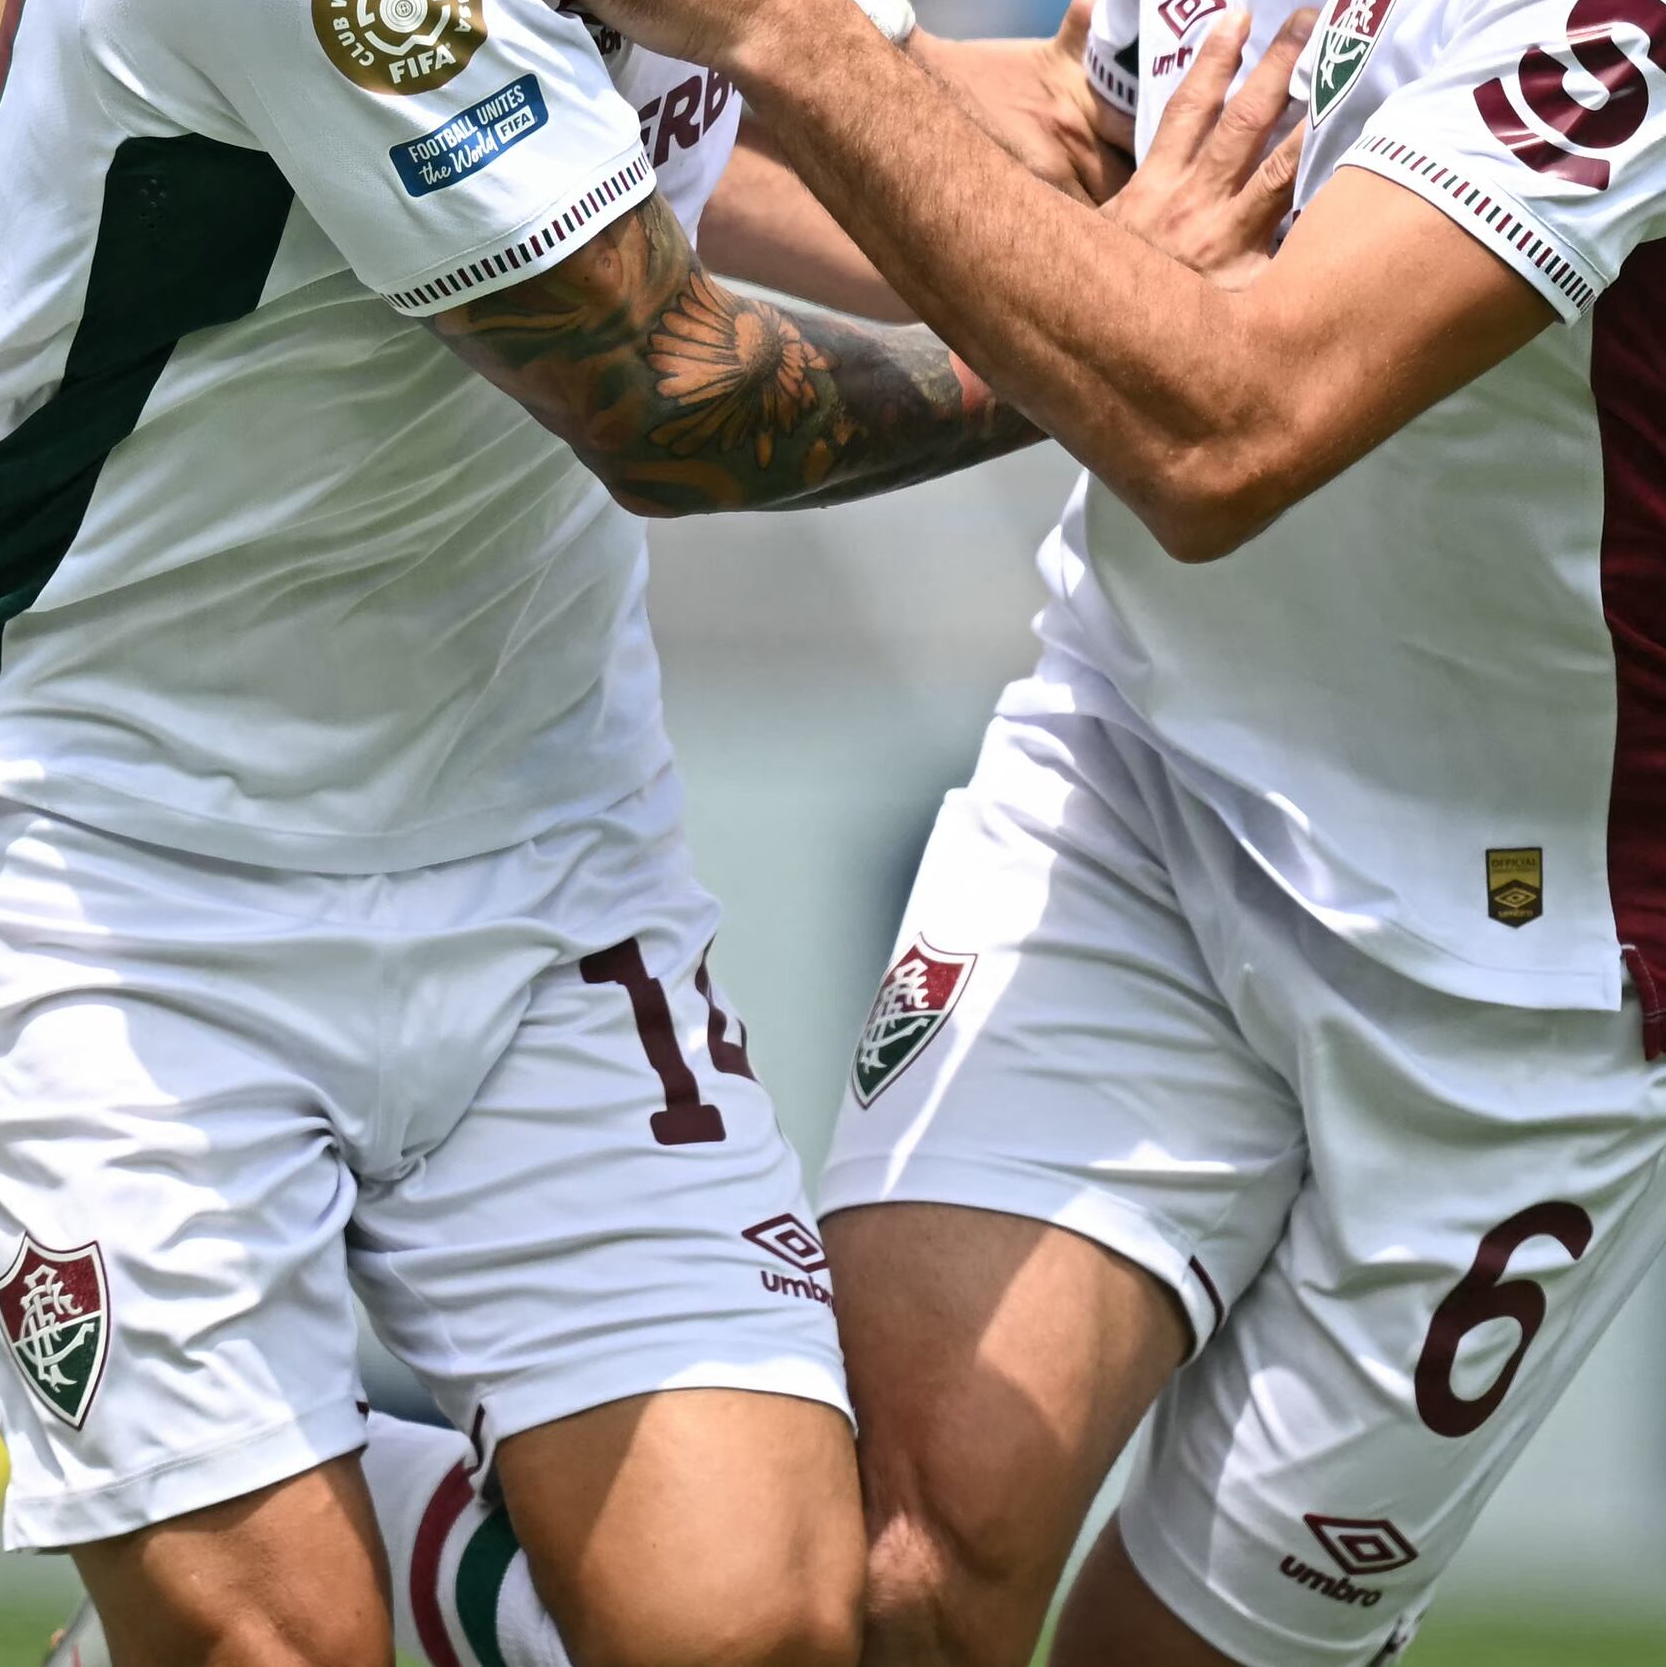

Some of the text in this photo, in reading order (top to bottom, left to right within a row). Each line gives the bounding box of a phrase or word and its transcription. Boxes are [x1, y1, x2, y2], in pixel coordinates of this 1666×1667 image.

[333, 16, 375, 67] CLUB
[389, 43, 456, 84] FIFA
[408, 84, 525, 163] FOOTBALL UNITES
[499, 112, 532, 138] FIFA
[419, 127, 499, 185] the World
[1414, 1200, 1593, 1437] 6
[1279, 1554, 1383, 1608] umbro
